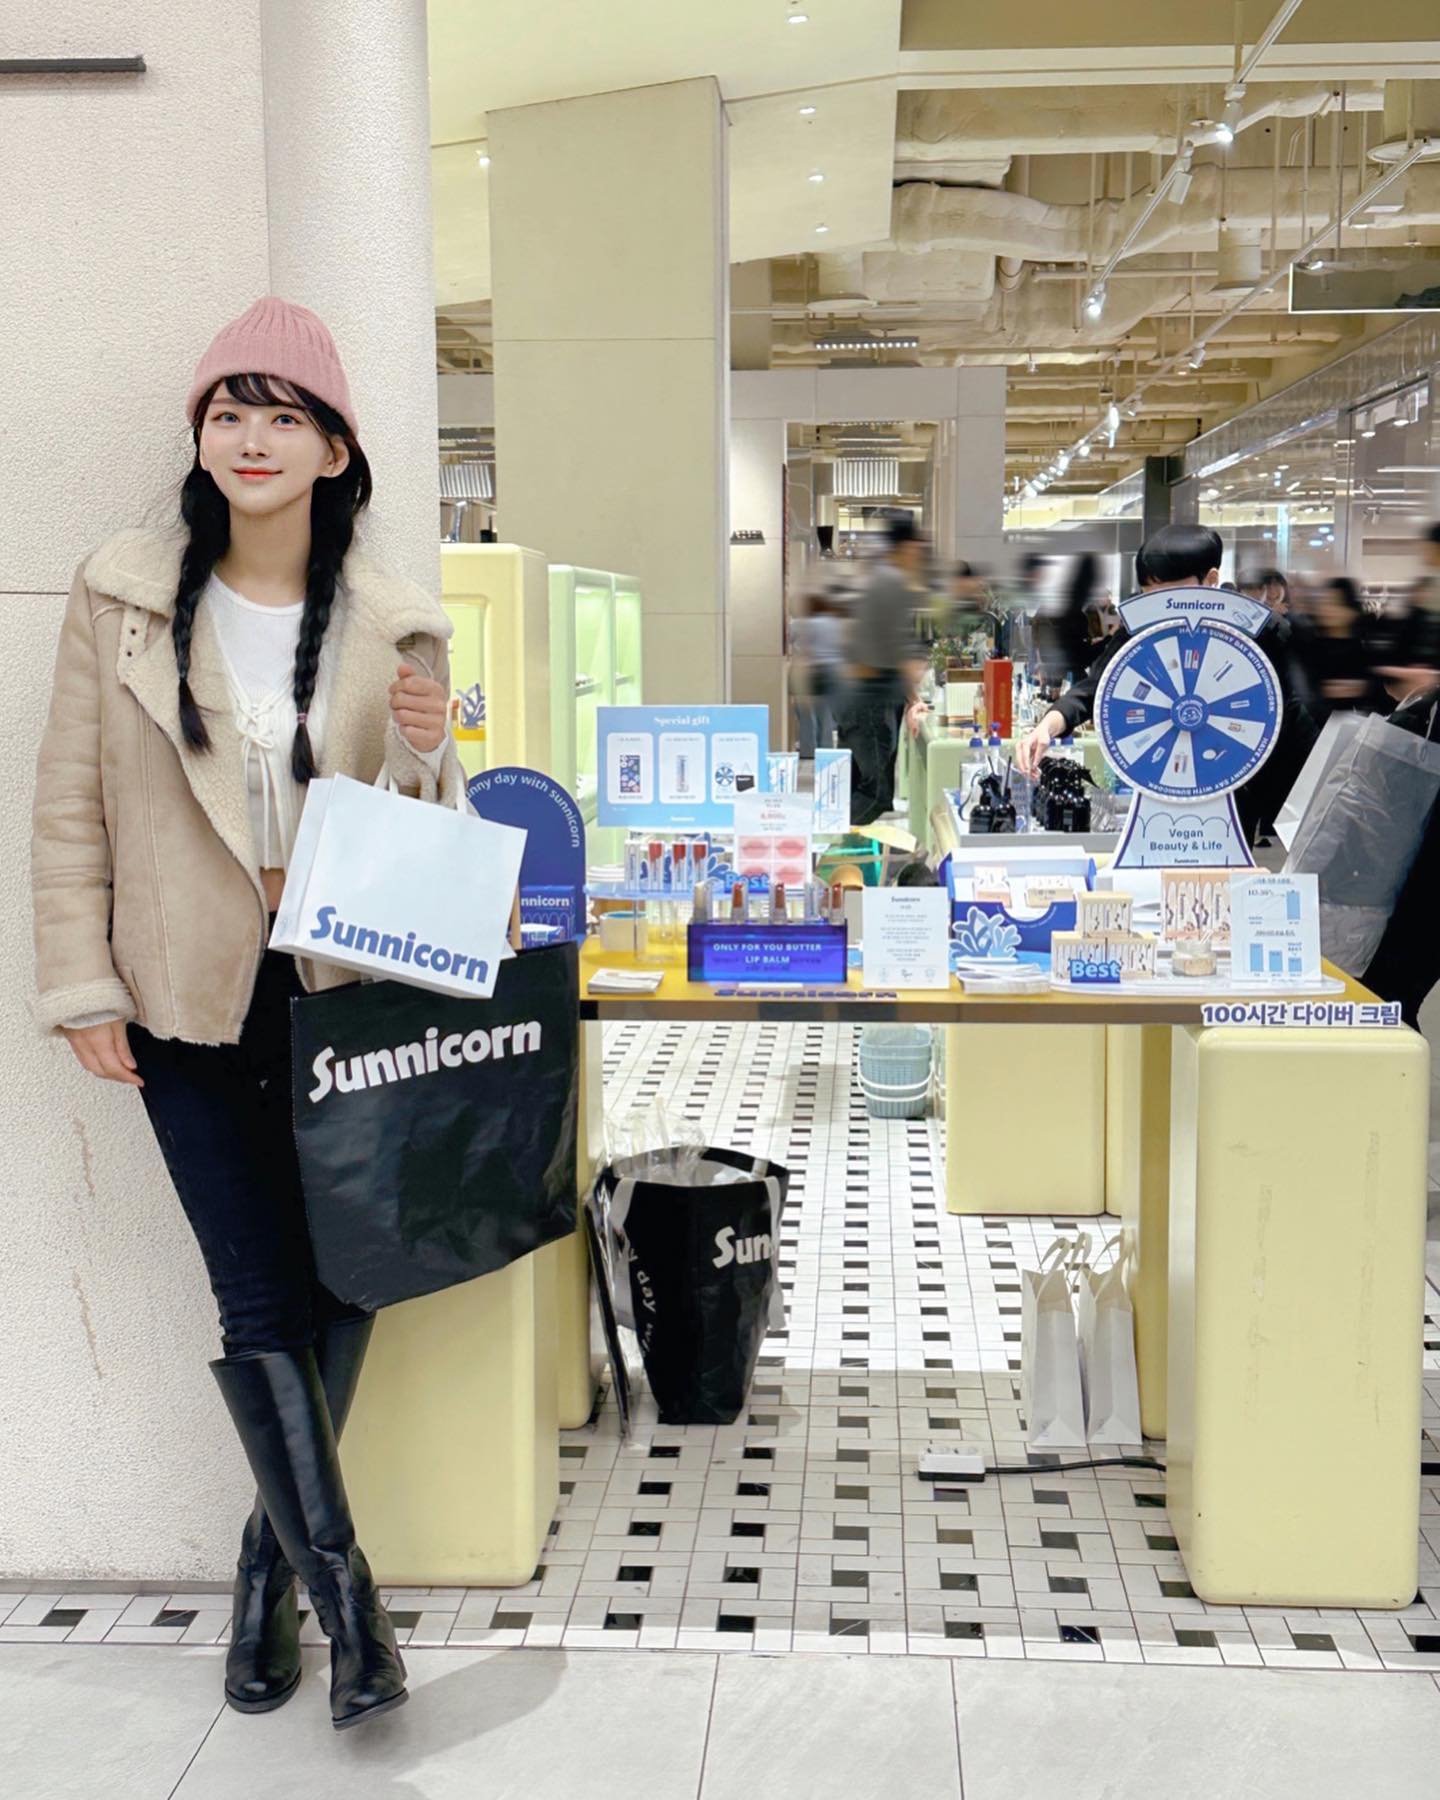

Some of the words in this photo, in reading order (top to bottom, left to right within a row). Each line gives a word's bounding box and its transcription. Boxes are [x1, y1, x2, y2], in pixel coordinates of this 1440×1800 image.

[1166, 597, 1225, 610] Sunnicorn
[1233, 639, 1248, 653] DAY
[1246, 651, 1263, 669] WITH
[1104, 680, 1115, 701] WITH
[654, 715, 691, 726] Special
[692, 715, 710, 726] gift
[1102, 719, 1114, 744] SUNNY
[1253, 736, 1268, 758] HAVE
[1112, 750, 1129, 770] HAVE
[465, 778, 491, 799] unny
[494, 773, 518, 786] day
[521, 775, 549, 792] with
[549, 789, 580, 848] sunnicorn
[1169, 828, 1203, 839] Vegan
[1150, 841, 1190, 852] Beauty
[1192, 841, 1199, 850] &
[1202, 841, 1222, 851] Life
[521, 895, 570, 906] nnicorn
[310, 906, 489, 984] Sunnicorn
[713, 943, 739, 951] ONLY
[742, 943, 760, 951] FOR
[763, 943, 783, 951] YOU
[786, 943, 821, 951] BUTTER
[745, 956, 760, 964] LIP
[763, 956, 790, 964] BALM
[1072, 961, 1119, 977] Best
[1203, 1004, 1287, 1025] 100시간
[1293, 1004, 1353, 1025] 다이버
[1360, 1004, 1400, 1025] 크림
[308, 1020, 542, 1103] Sunnicorn
[637, 1270, 656, 1312] day
